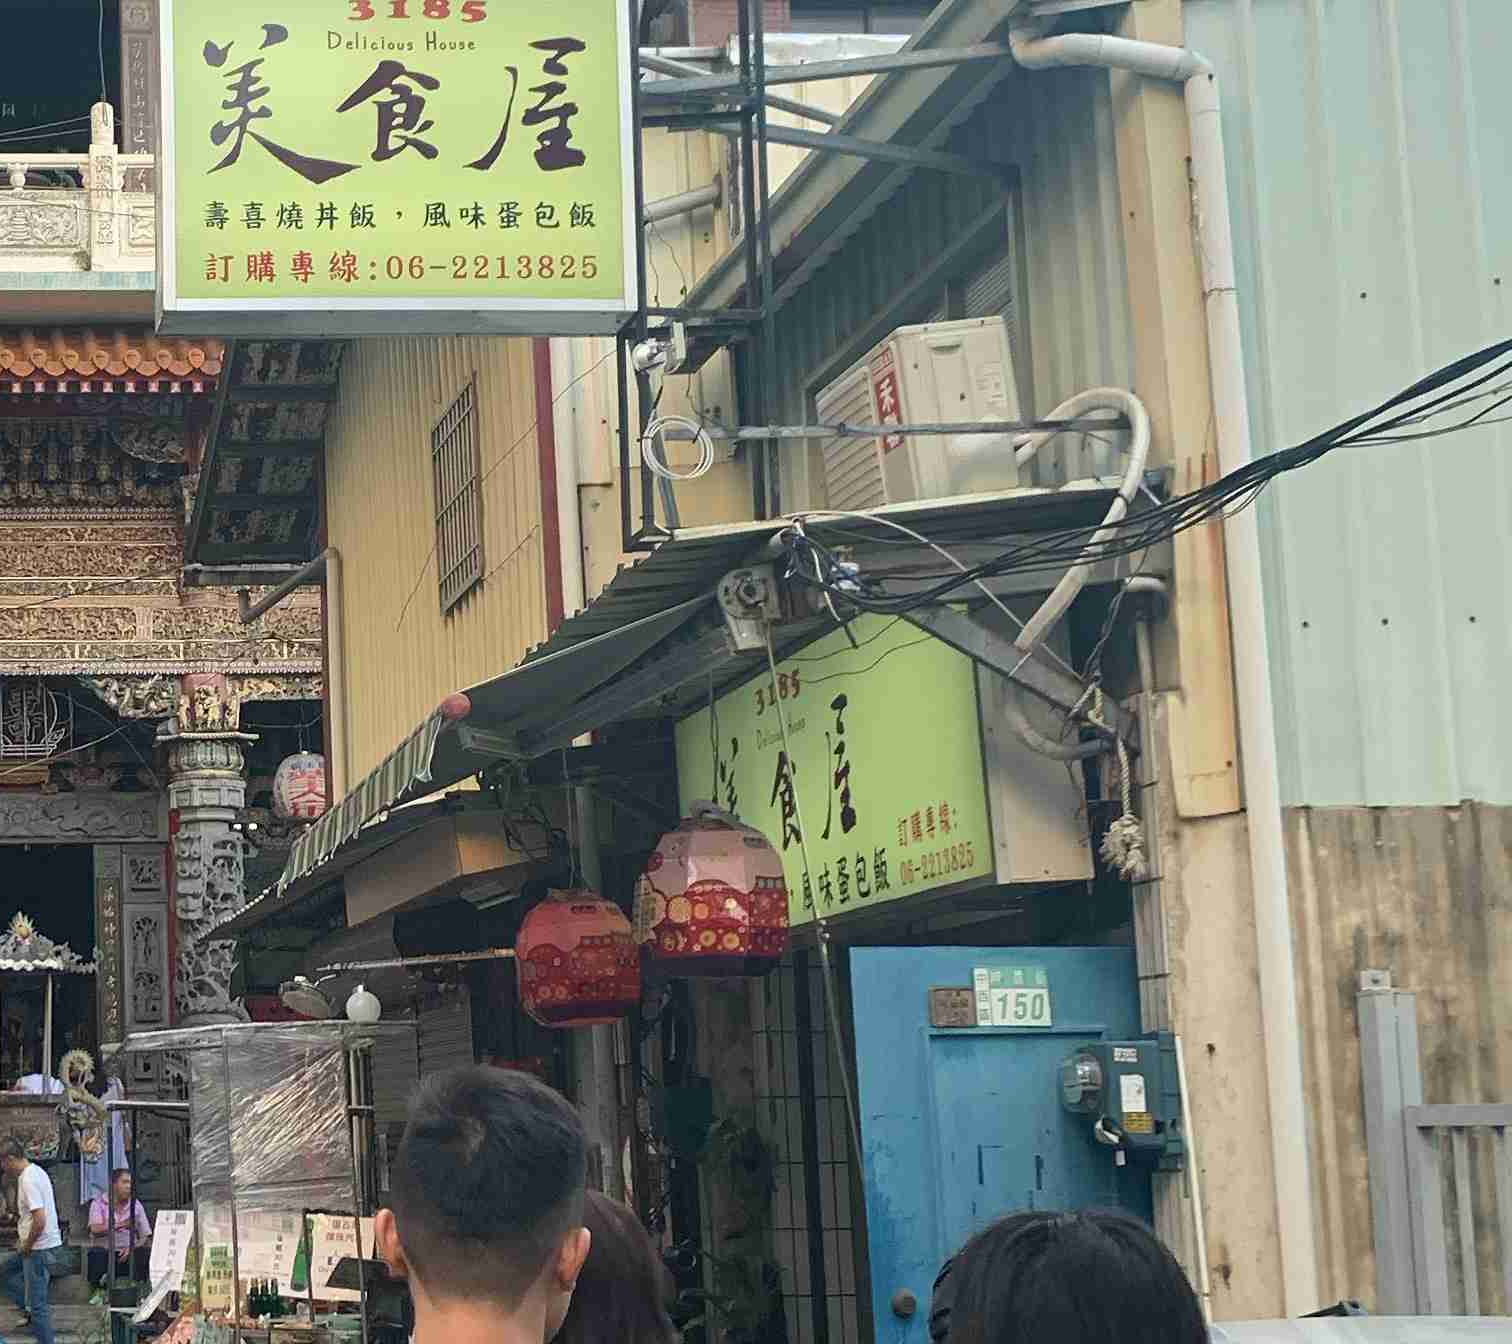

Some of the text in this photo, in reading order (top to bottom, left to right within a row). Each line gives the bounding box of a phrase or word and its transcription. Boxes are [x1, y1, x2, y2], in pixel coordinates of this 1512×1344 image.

[326, 30, 476, 53] Delicious House
[202, 23, 587, 185] 美食屋
[997, 992, 1045, 1020] 150
